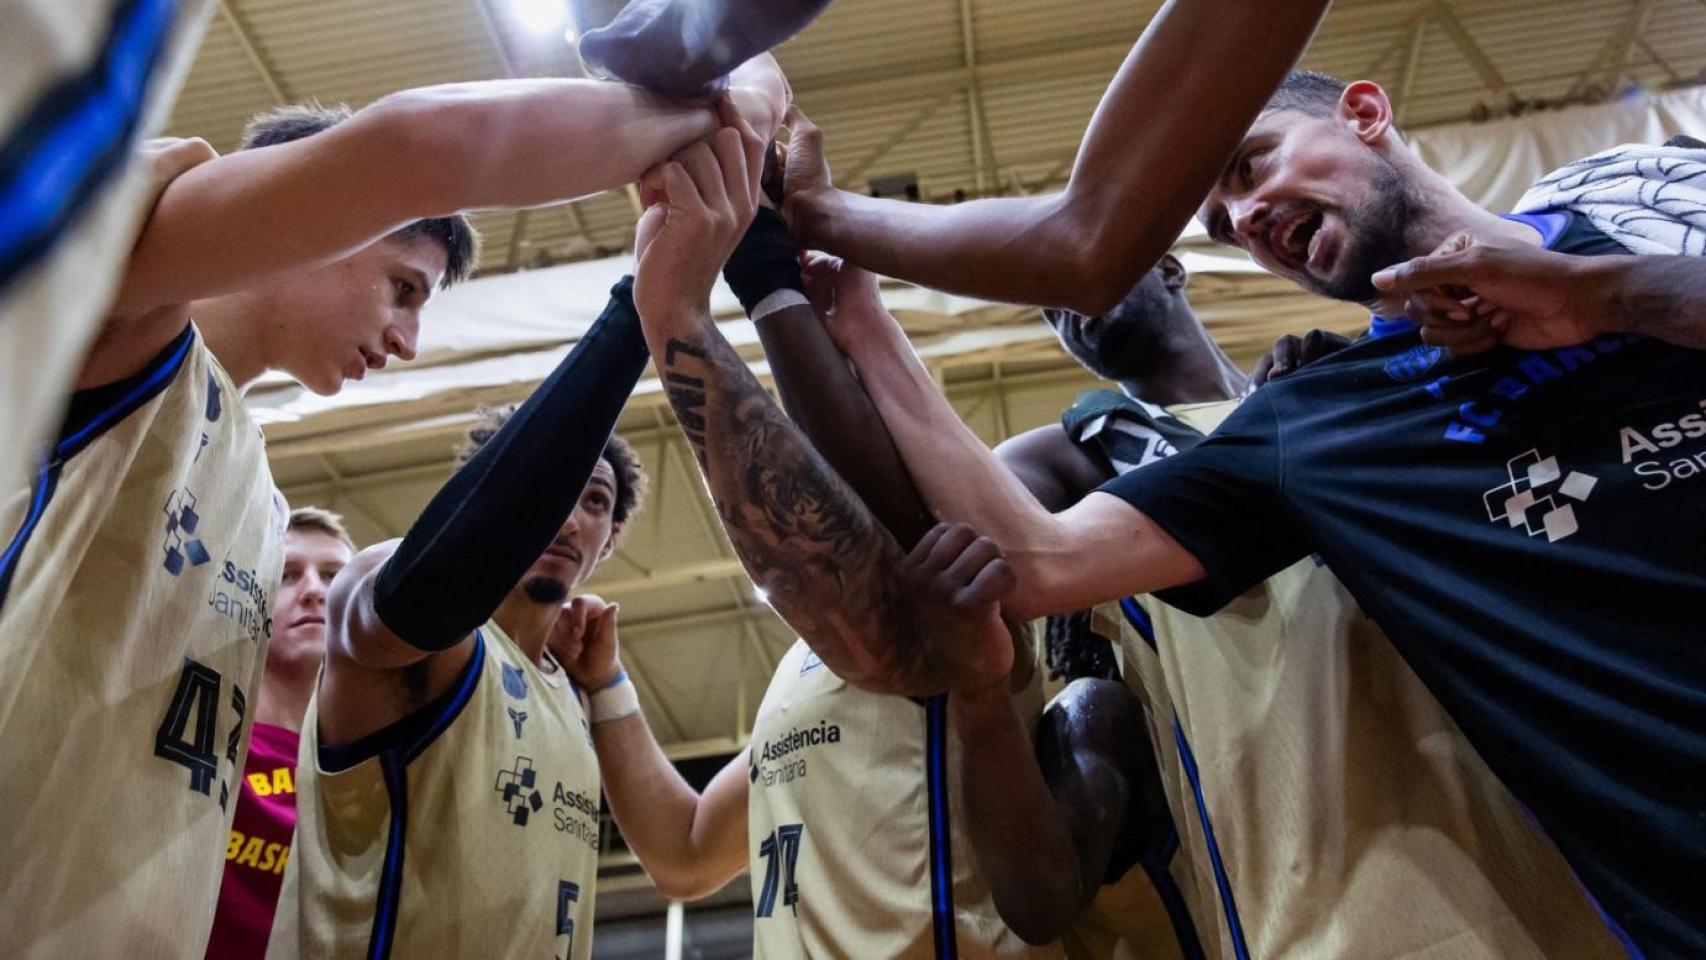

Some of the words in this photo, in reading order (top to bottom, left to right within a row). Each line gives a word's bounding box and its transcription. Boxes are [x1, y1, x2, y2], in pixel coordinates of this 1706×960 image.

[1443, 402, 1501, 444] FC
[760, 719, 841, 763] Assistència
[247, 767, 297, 797] BA
